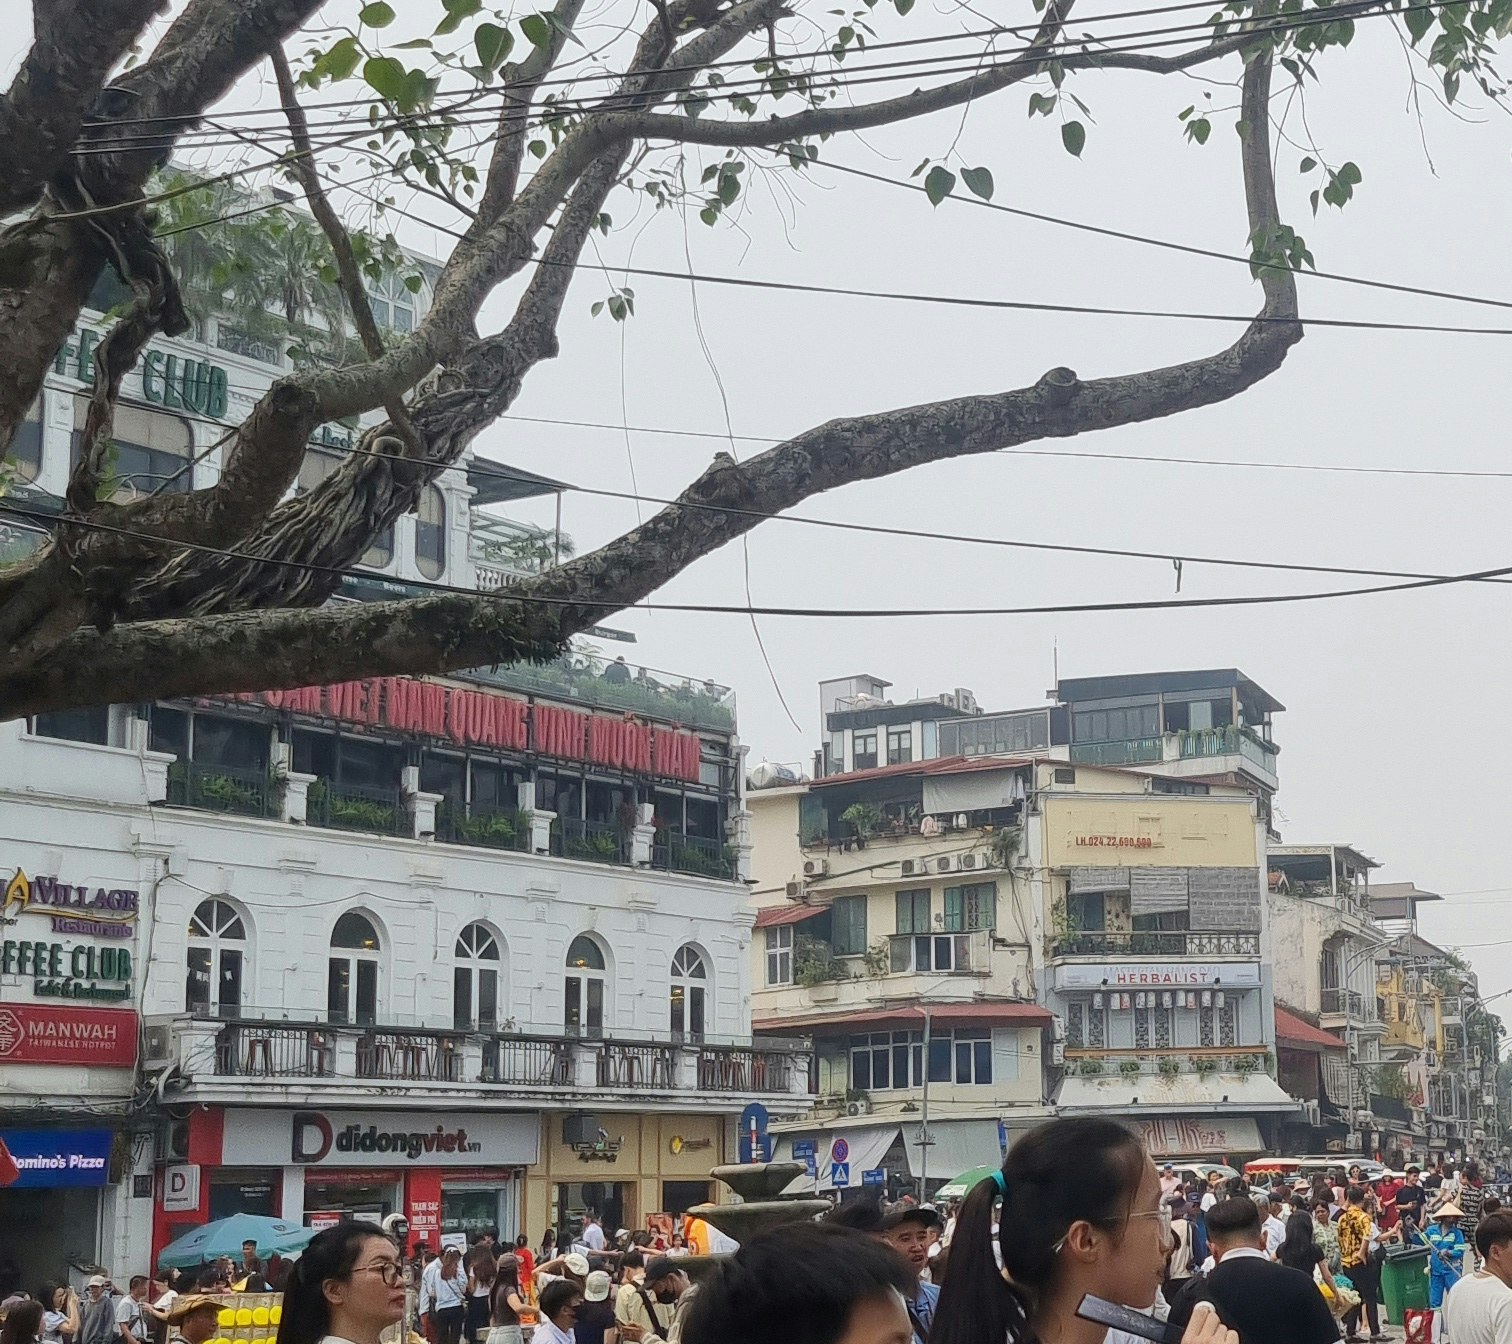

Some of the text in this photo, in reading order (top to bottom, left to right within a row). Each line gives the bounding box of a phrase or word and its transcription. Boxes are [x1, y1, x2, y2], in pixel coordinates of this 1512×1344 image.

[142, 349, 228, 419] CLUB
[450, 688, 527, 752] QUANG
[532, 704, 585, 760] VINH
[0, 939, 132, 982] FFEE CLUB
[1117, 972, 1208, 985] HERBALIST
[28, 1020, 117, 1040] MANWAH
[69, 1154, 104, 1169] Pizza
